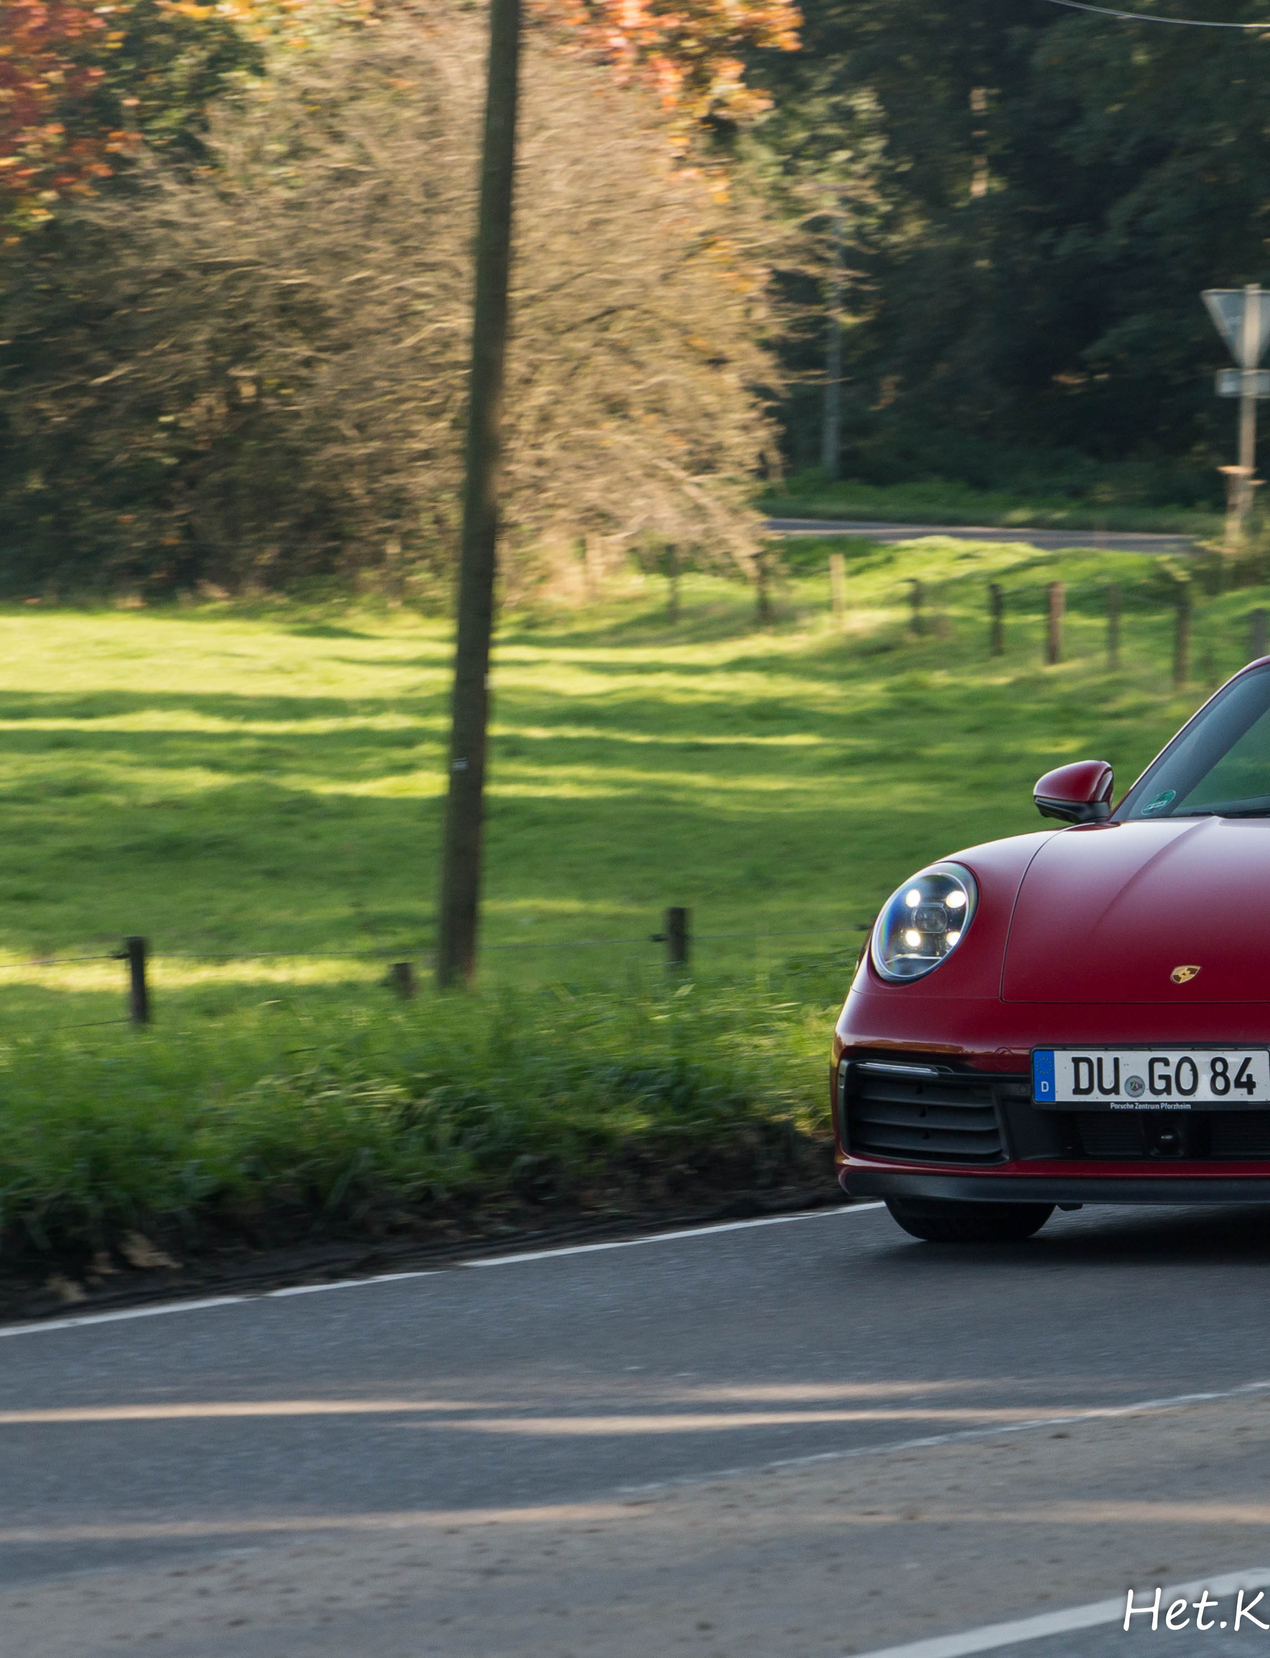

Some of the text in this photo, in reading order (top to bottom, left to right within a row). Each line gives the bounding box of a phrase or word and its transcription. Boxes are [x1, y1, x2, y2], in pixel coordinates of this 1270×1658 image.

[1071, 1055, 1257, 1096] DU GO 84
[1040, 1081, 1049, 1093] D
[1110, 1102, 1192, 1110] Porsche Zentrum Pforzheim
